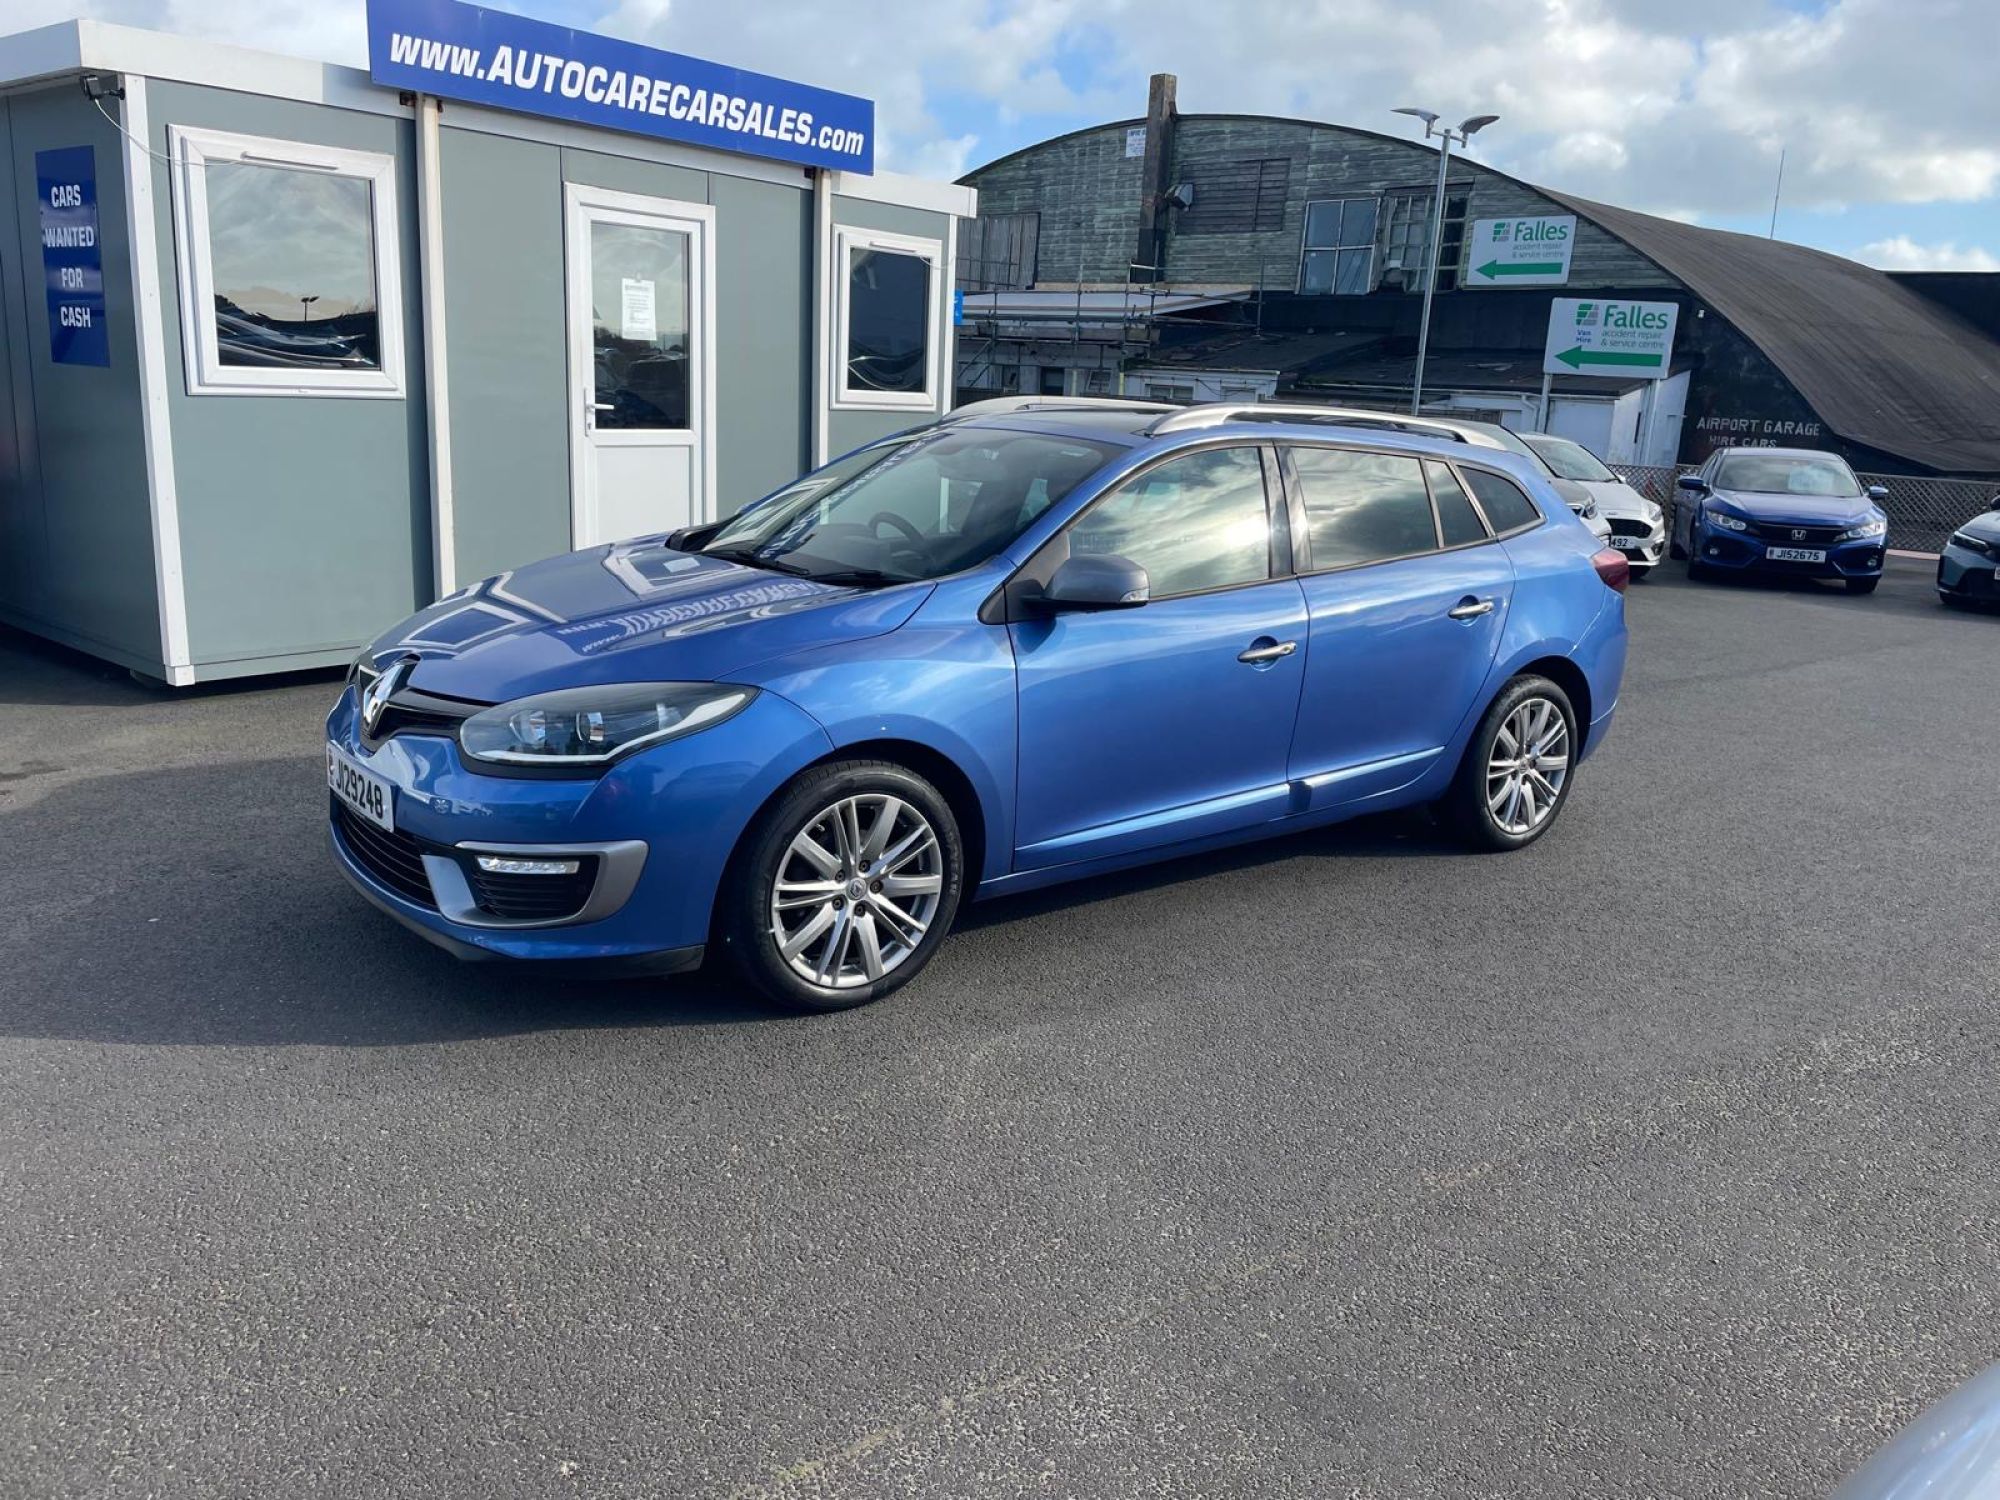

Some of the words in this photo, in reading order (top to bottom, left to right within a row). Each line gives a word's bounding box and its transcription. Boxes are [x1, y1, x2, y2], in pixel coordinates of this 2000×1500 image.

[390, 32, 864, 156] www.AUTOCARECARSALES.com
[51, 184, 81, 208] CARS
[45, 225, 95, 248] WANTED
[1514, 220, 1569, 242] Falles
[61, 268, 84, 289] FOR
[60, 306, 91, 328] CASH
[1603, 304, 1669, 330] Falles
[1601, 329, 1636, 339] accident
[1638, 331, 1663, 342] repair
[1609, 339, 1637, 348] service
[1638, 340, 1665, 349] centre
[1696, 417, 1761, 432] AIRPORT
[1763, 419, 1821, 437] GARAGE
